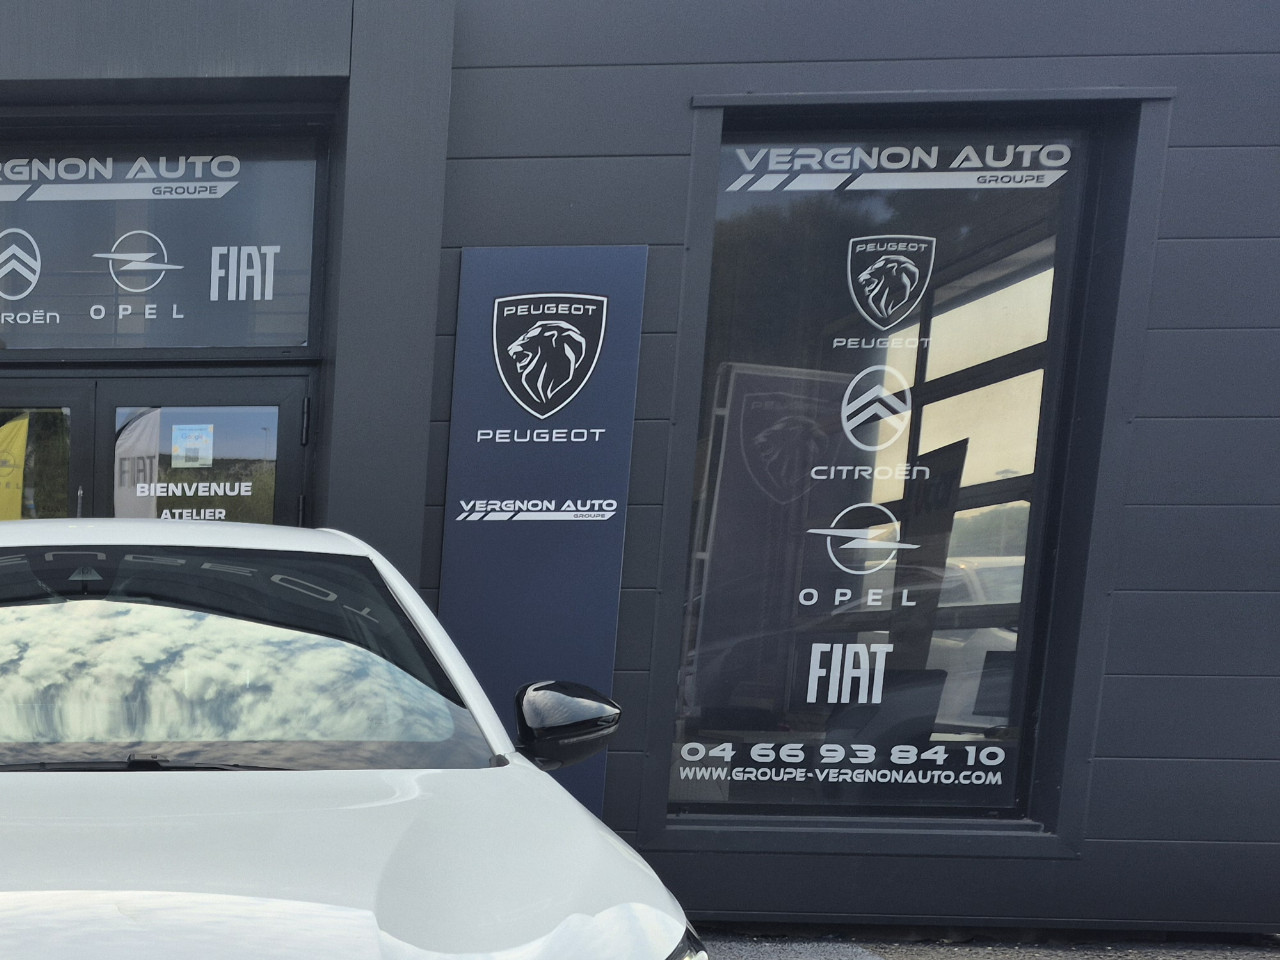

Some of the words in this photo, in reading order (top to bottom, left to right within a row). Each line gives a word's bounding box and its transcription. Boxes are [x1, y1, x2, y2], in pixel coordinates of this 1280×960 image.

[735, 145, 939, 171] VERGNON
[949, 144, 1071, 168] AUTO
[125, 155, 241, 179] AUTO
[976, 174, 1045, 185] GROUPE
[152, 185, 218, 195] GROUPE
[855, 242, 928, 253] PEUGEOT
[210, 245, 280, 301] FIAT
[90, 304, 184, 320] OPEL
[503, 303, 597, 317] PEUGEOT
[832, 337, 932, 350] PEUGEOT
[477, 428, 606, 443] PEUGEOT
[136, 482, 252, 497] BIENVENUE
[459, 500, 556, 512] VERGNON
[560, 499, 618, 511] AUTO
[160, 508, 226, 520] ATELIER
[798, 588, 917, 606] OPEL
[806, 643, 894, 704] FIAT
[680, 742, 737, 762] 04
[750, 743, 805, 763] 66
[819, 744, 876, 764] 93
[890, 744, 949, 765] 84
[965, 745, 1006, 766] 10
[679, 766, 1003, 785] WWW.GROUPE-VERGNONAUTO.COM
